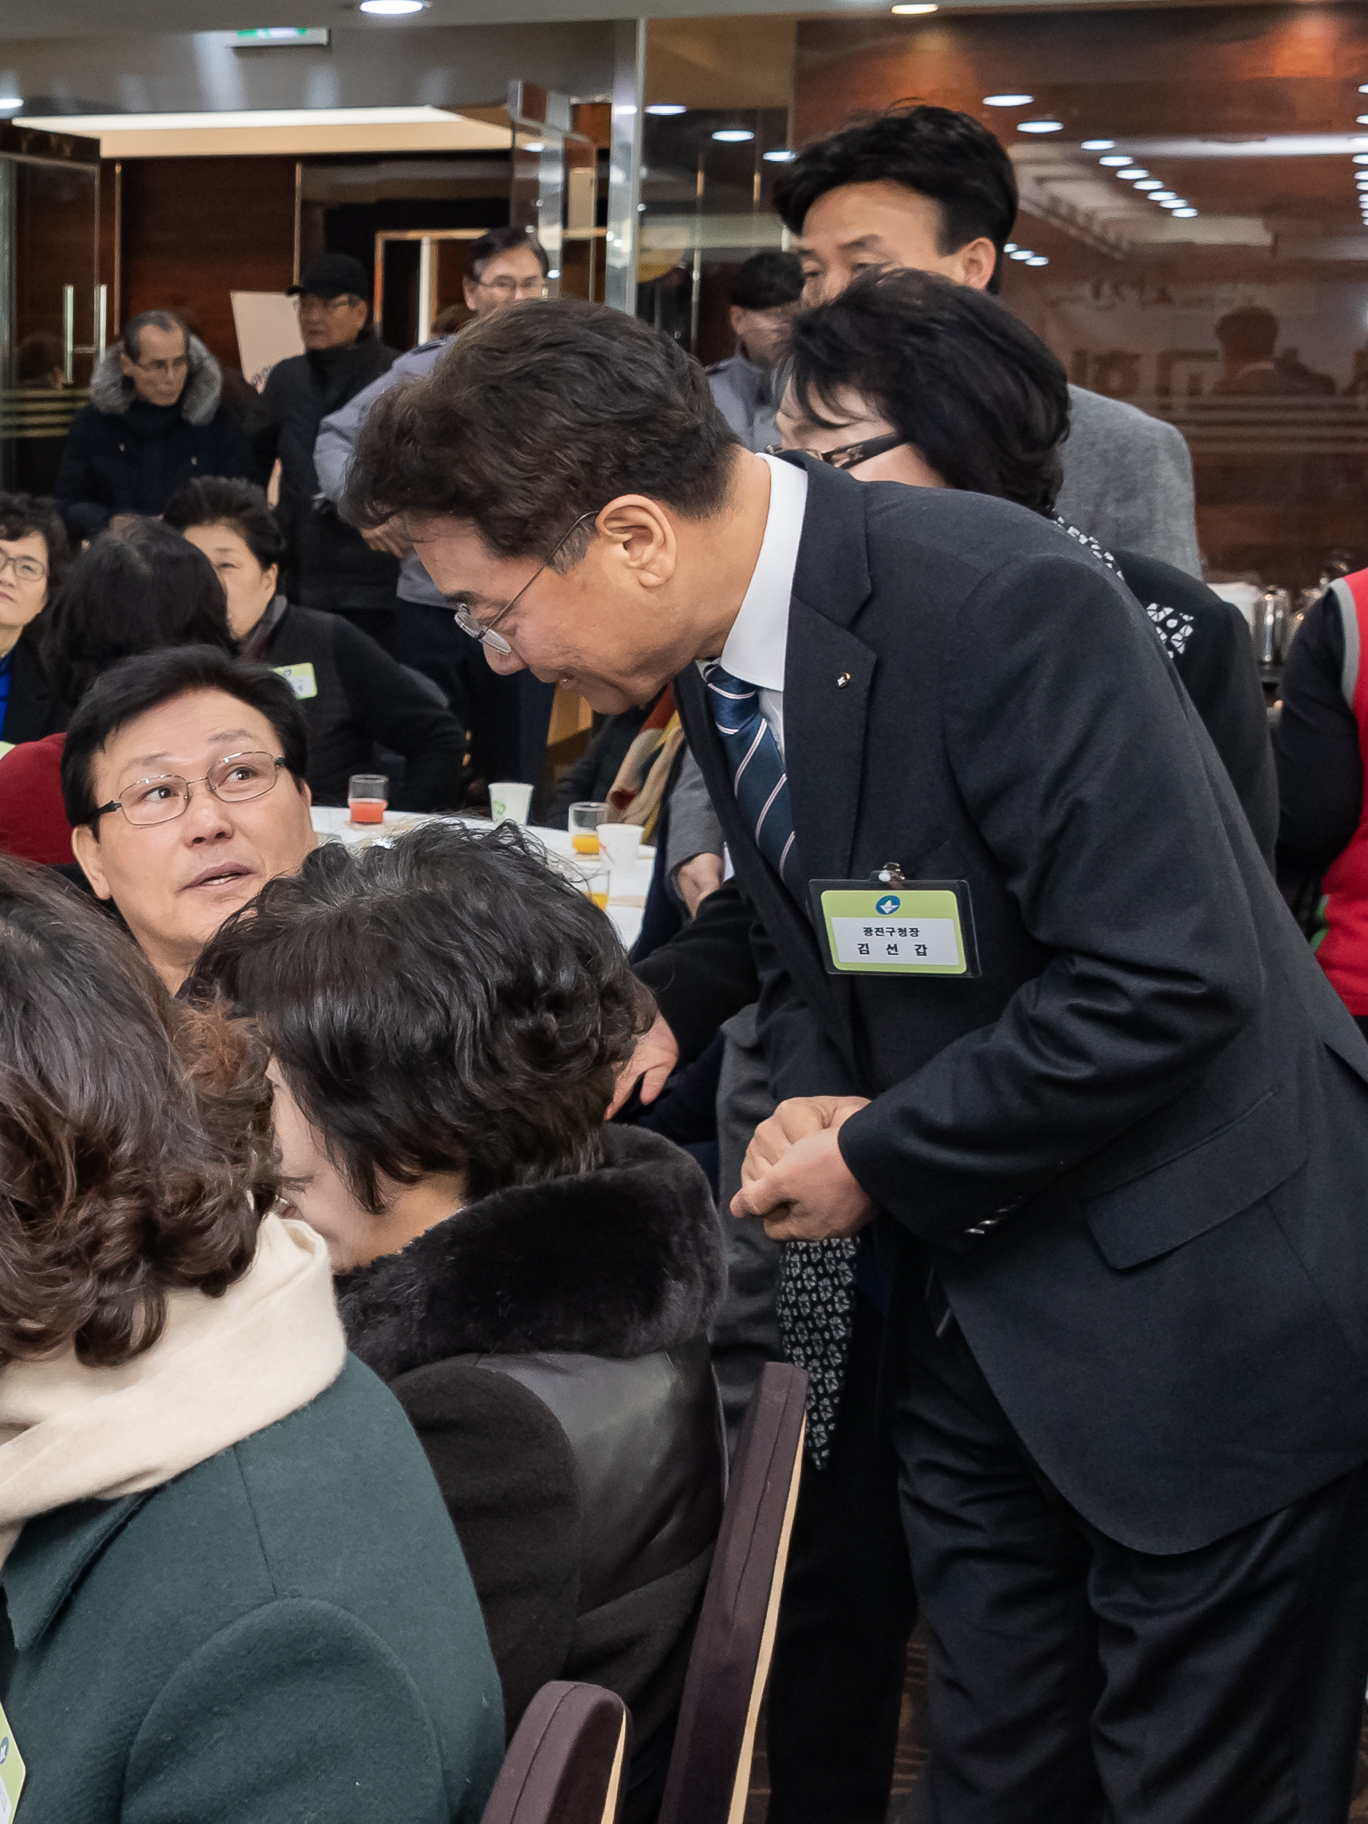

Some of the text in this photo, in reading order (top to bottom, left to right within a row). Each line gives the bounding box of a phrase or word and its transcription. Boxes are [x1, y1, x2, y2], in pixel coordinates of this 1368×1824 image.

[863, 927, 920, 938] 광진구청장
[857, 943, 928, 957] 김 선 갑
